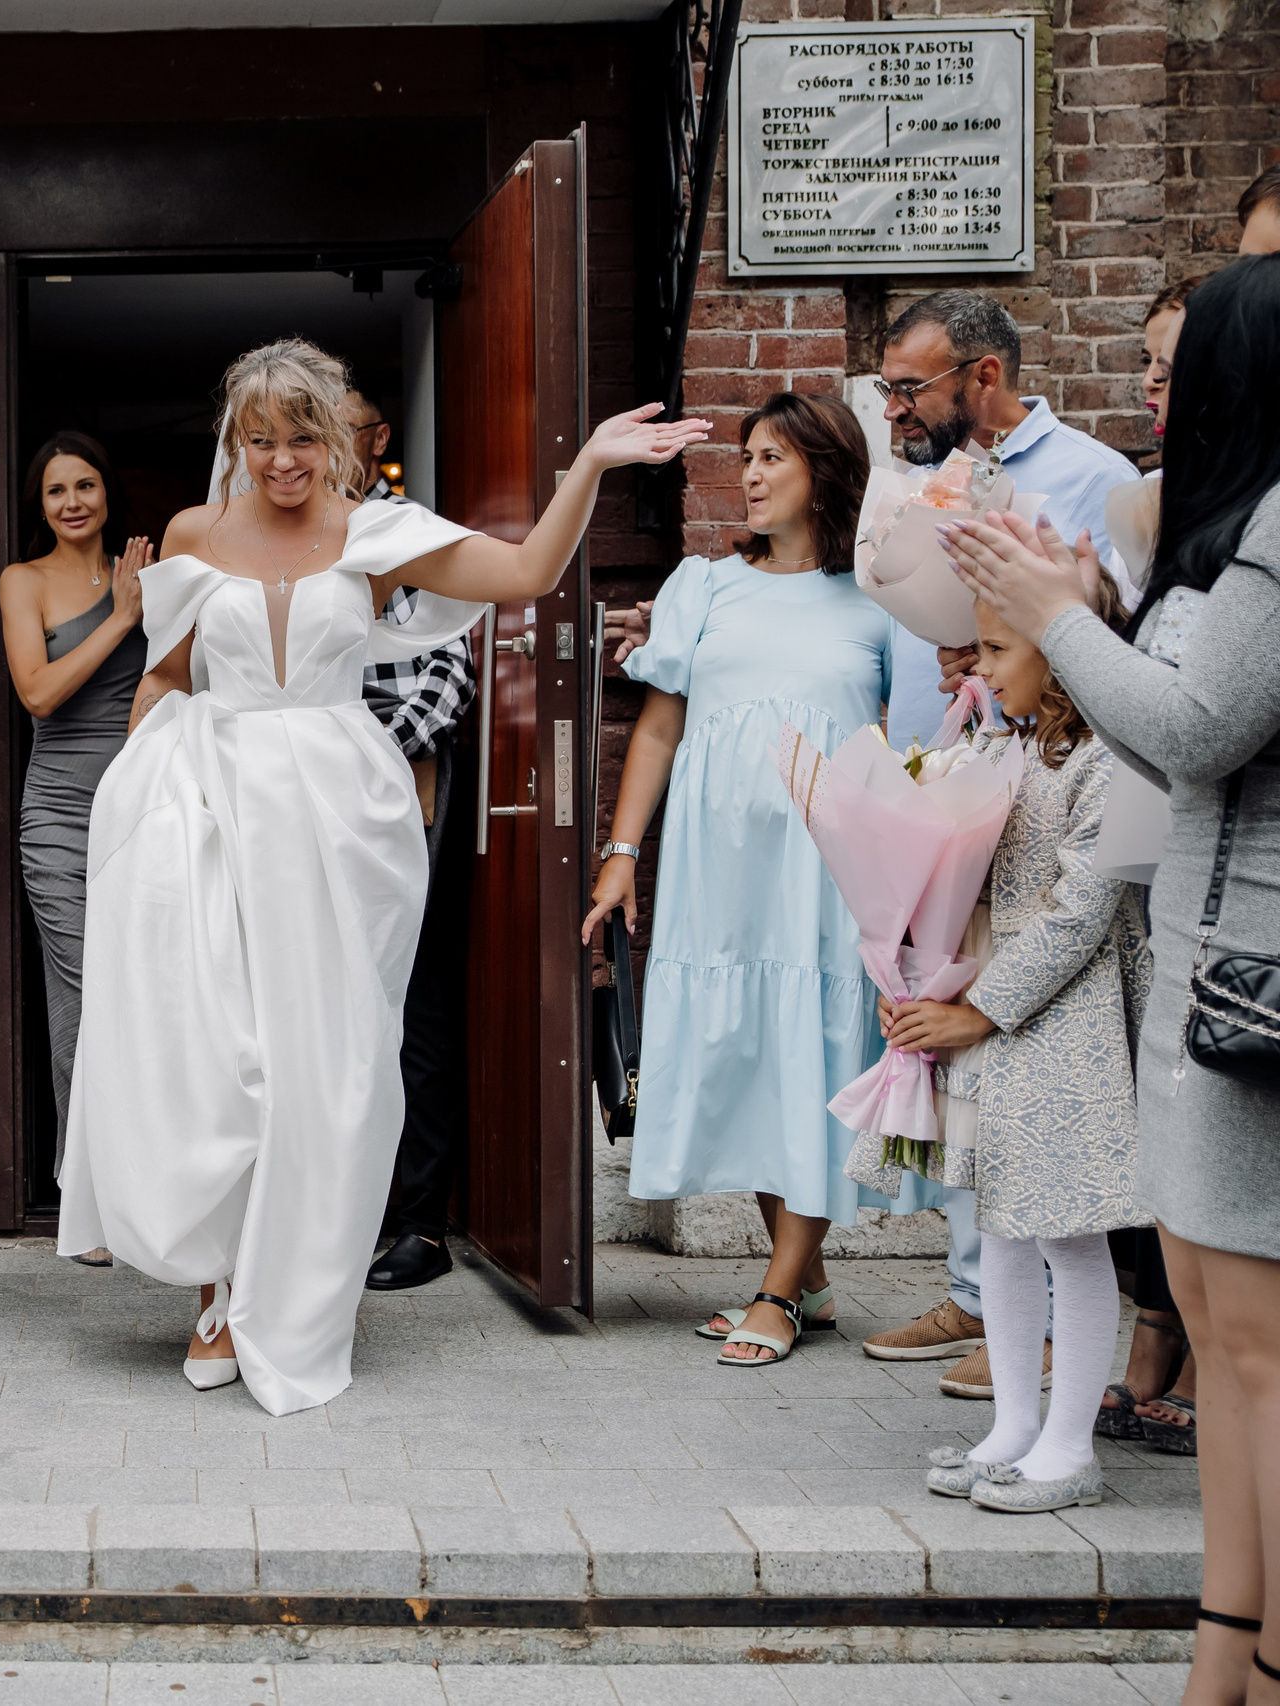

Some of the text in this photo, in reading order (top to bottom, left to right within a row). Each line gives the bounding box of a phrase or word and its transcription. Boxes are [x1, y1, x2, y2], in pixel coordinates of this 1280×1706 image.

[790, 41, 973, 56] РАСПОРЯДОК РАБОТЫ
[869, 57, 973, 71] с 8:30 до 17:30
[798, 73, 973, 91] суббота с 8:30 до 16:15
[878, 93, 923, 101] ГРАЖДАН
[762, 107, 836, 119] ВТОРНИК
[762, 123, 811, 134] СРЕДА
[896, 118, 1001, 132] с 9:00 до 16:00
[763, 139, 829, 151] ЧЕТВЕРГ
[762, 155, 1000, 170] ТОРЖЕСТВЕННАЯ РЕГИСТРАЦИЯ
[806, 171, 957, 183] ЗАКЛЮЧЕНИЯ БРАКА
[762, 188, 1001, 204] ПЯТНИЦА с 8:30 до 16:30
[762, 205, 1001, 221] СУББОТА с 8:30 до 15:30
[762, 222, 1001, 238] ОБЕДЕННЫЙ ПЕРЕРЫВ с 13:00 до 13:45
[913, 242, 989, 251] ПОНЕДЕЛЬНИК
